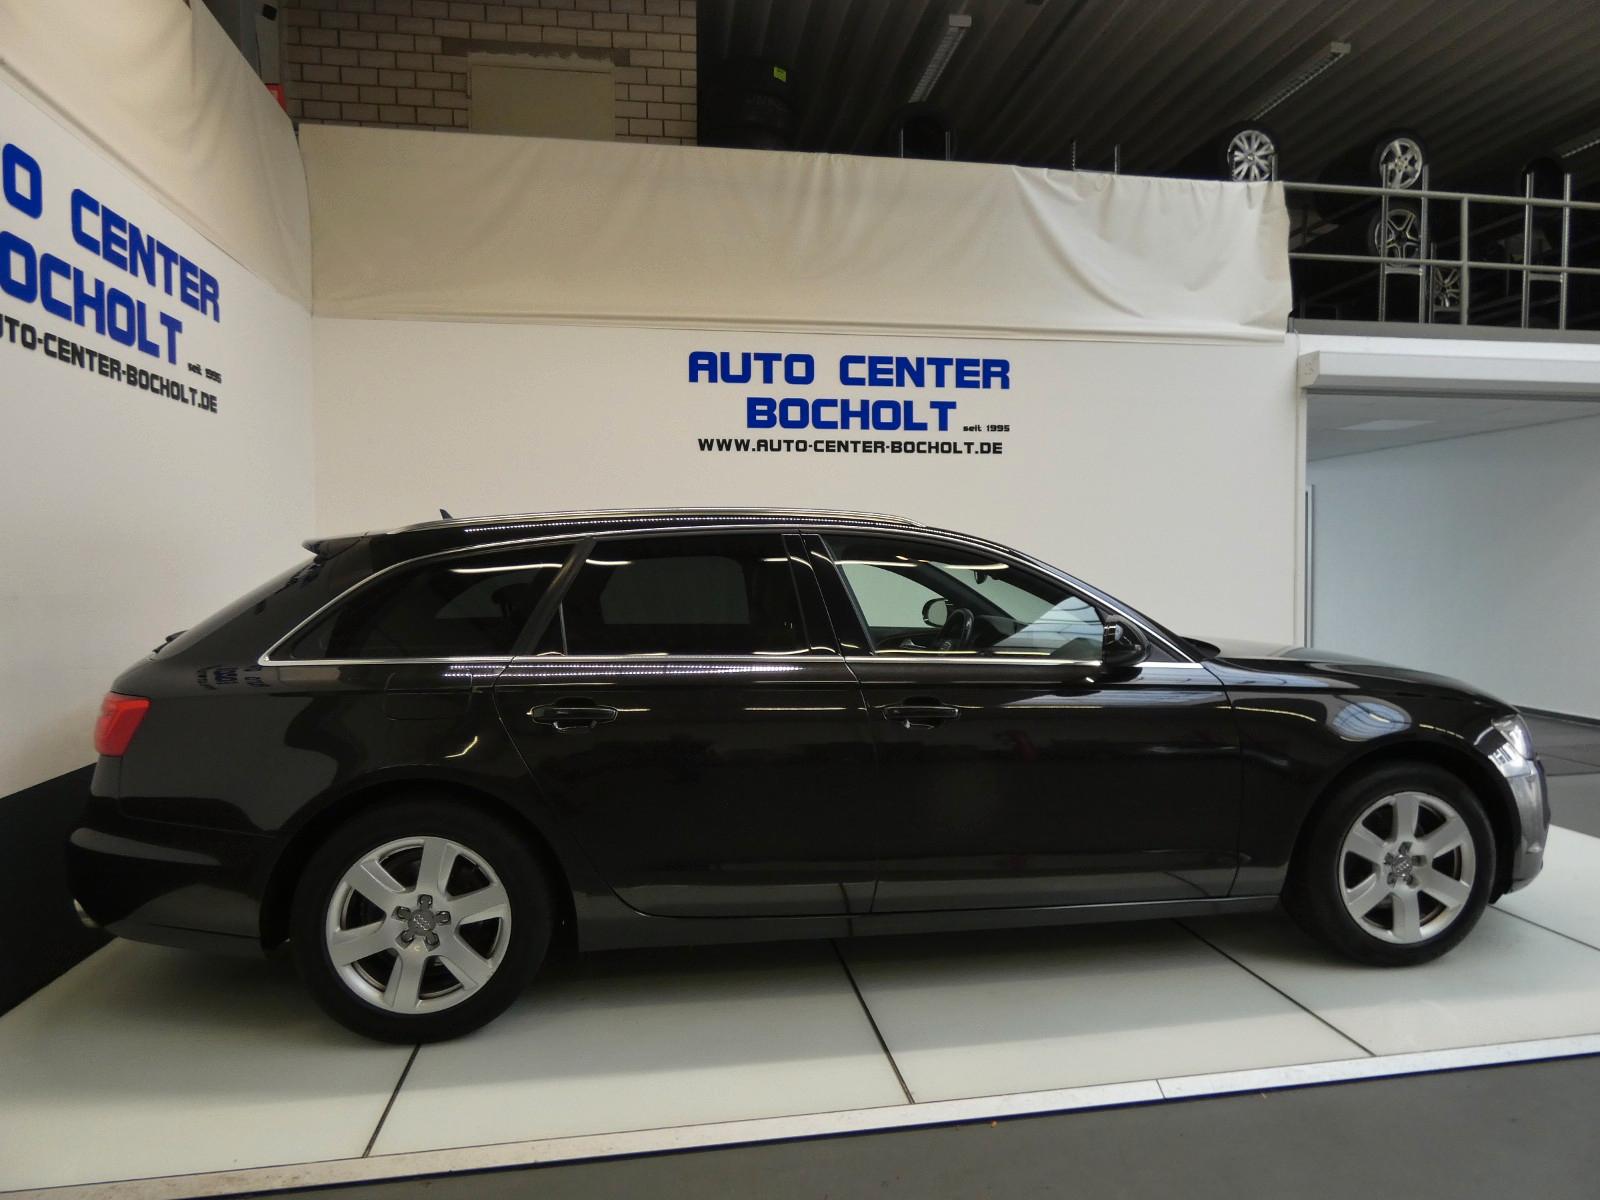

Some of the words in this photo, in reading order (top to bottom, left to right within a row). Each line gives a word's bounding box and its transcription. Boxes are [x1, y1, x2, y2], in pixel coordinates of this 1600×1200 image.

[71, 188, 220, 323] CENTER
[689, 350, 815, 385] AUTO
[839, 354, 1010, 389] CENTER
[747, 397, 957, 432] BOCHOLT
[963, 424, 982, 432] seit
[986, 424, 1010, 432] 1995
[698, 438, 1003, 455] WWW.AUTO-CENTER-BOCHOLT.DE
